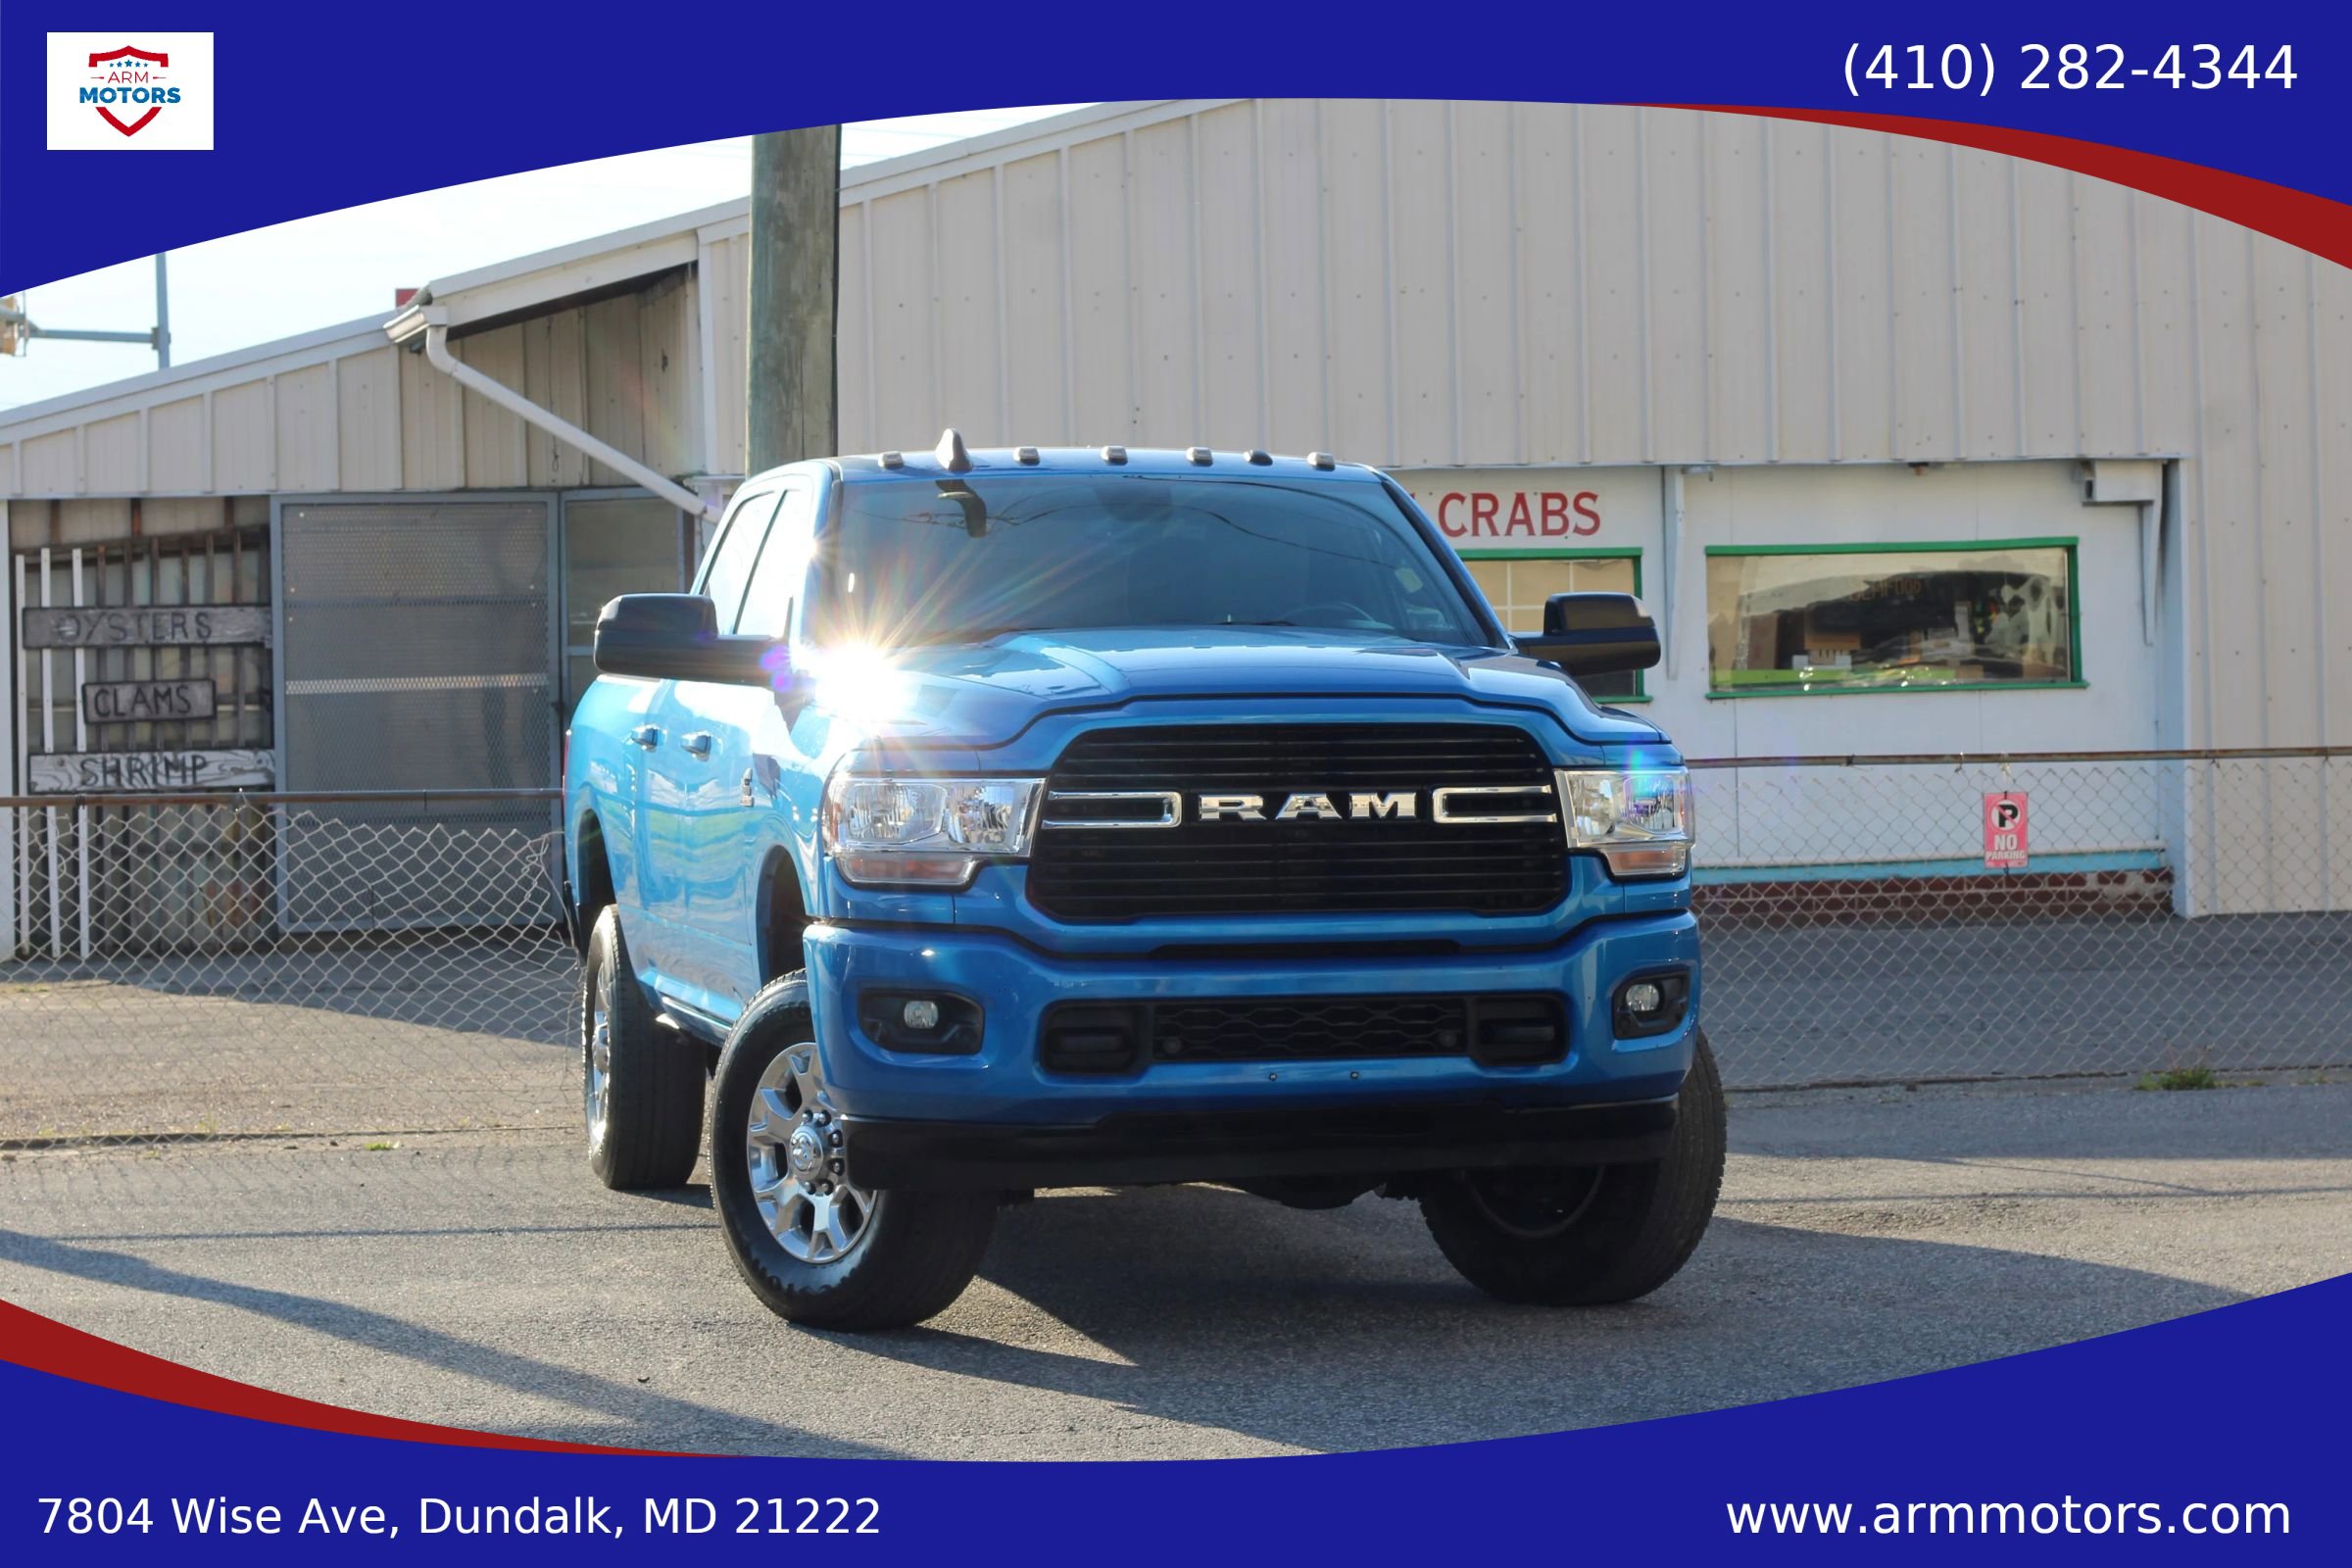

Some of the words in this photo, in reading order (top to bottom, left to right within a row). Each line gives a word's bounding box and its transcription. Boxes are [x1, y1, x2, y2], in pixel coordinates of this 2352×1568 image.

[1438, 490, 1601, 538] CRABS
[56, 612, 213, 642] OYSTERS
[94, 685, 191, 717] CLAMS
[80, 754, 209, 787] SHRIMP
[1199, 792, 1417, 821] RAM
[1985, 850, 2026, 860] PARKING
[1993, 834, 2018, 851] NO
